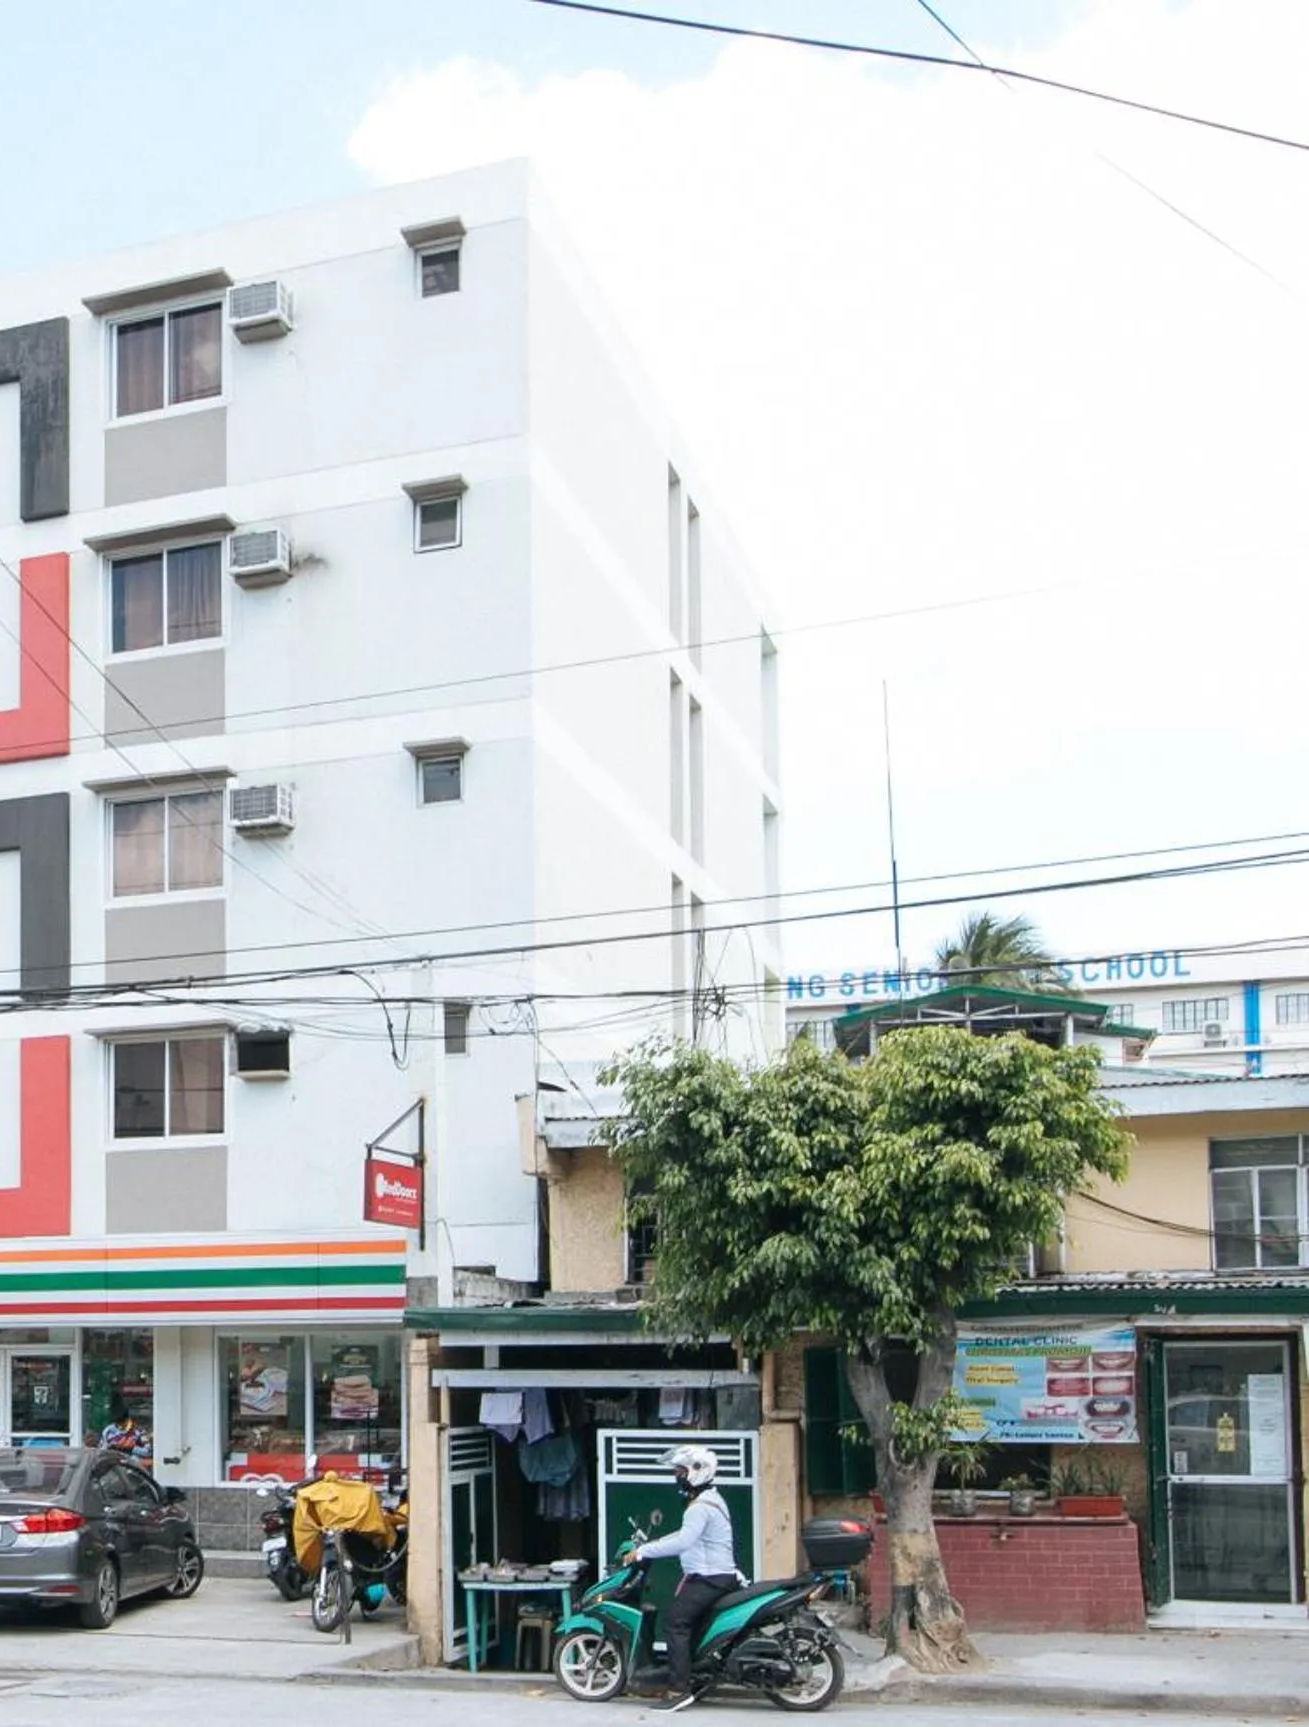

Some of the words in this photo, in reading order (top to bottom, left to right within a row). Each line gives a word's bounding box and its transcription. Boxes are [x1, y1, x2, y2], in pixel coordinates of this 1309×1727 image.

[840, 966, 948, 998] SENIO
[1056, 951, 1191, 984] SCHOOL
[1034, 1336, 1078, 1345] CLINIC
